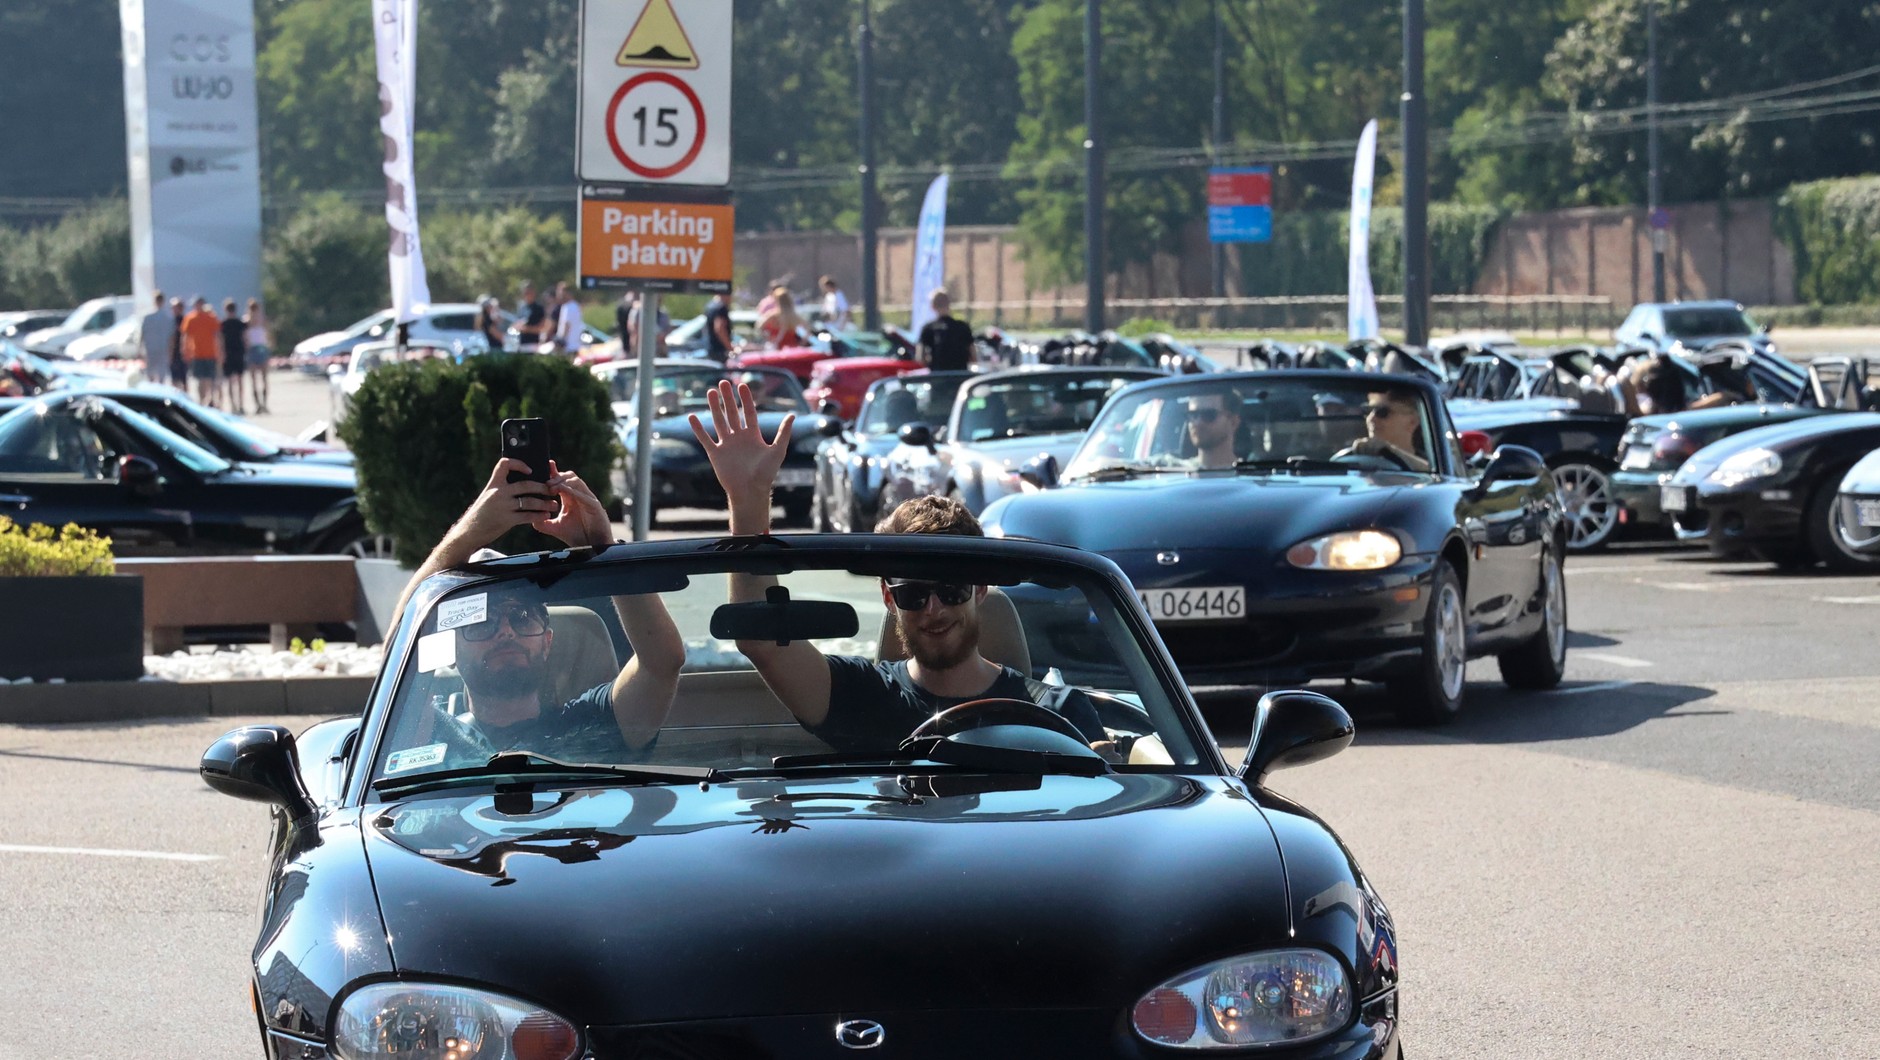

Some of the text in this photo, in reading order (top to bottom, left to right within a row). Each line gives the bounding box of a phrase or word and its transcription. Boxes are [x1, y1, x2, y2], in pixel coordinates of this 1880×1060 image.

[633, 106, 678, 147] 15
[603, 207, 714, 243] Parking
[611, 240, 704, 273] płatny
[1161, 590, 1241, 617] 06446
